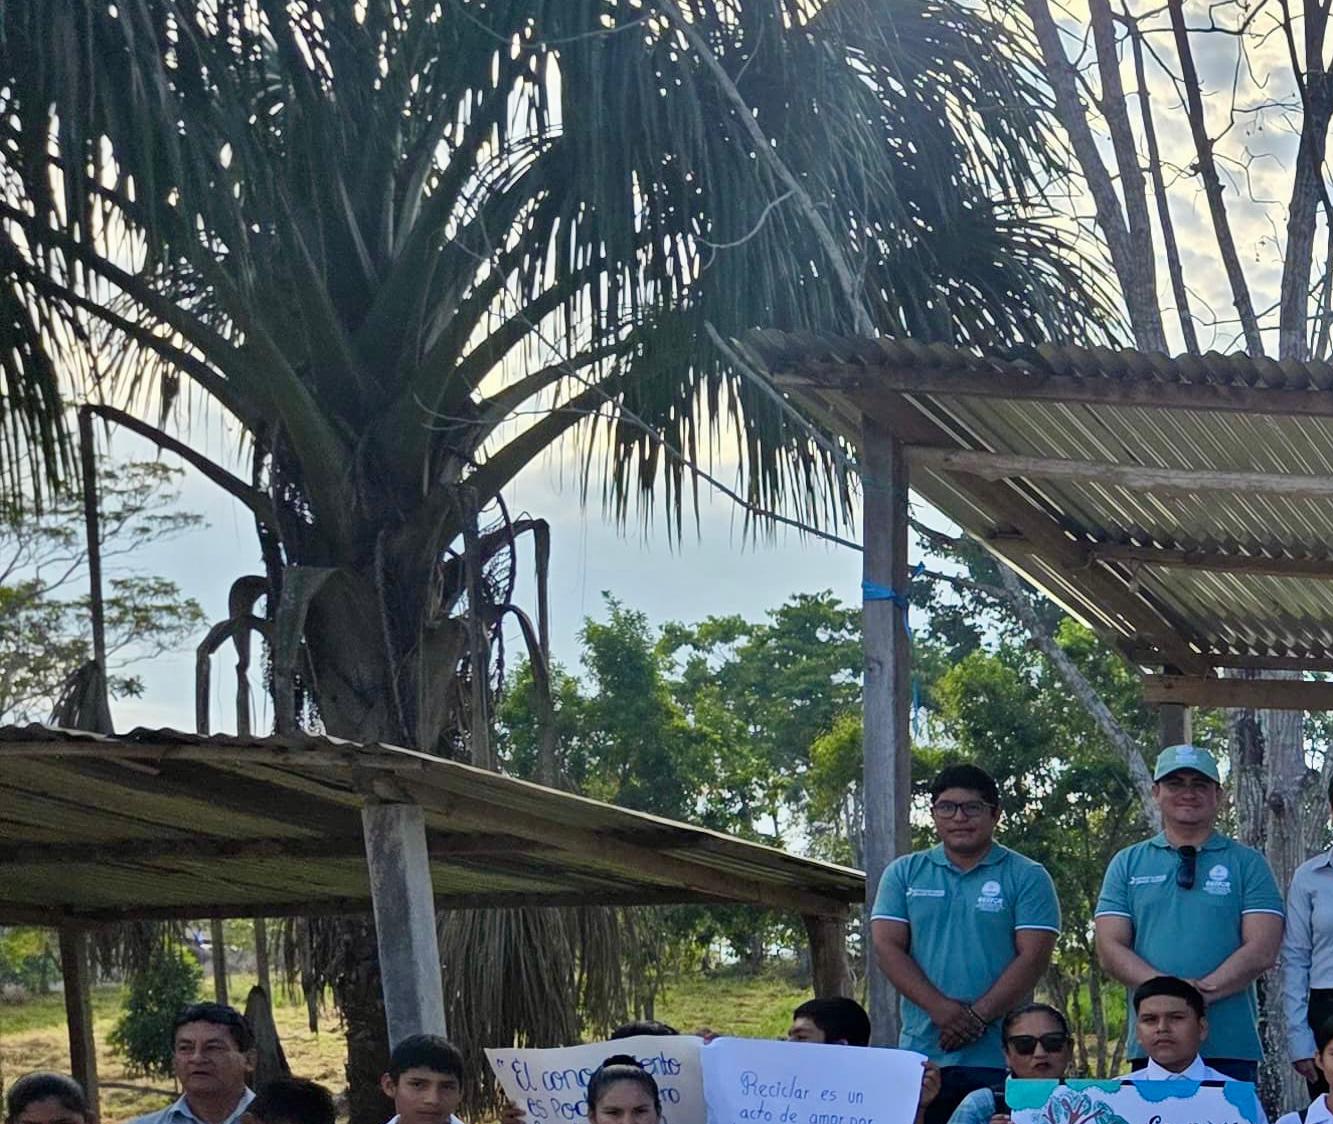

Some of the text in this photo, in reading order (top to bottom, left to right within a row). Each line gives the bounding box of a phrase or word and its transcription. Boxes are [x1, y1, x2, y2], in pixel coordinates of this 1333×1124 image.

[740, 1070, 864, 1104] Reciclar es un
[740, 1101, 772, 1121] acto
[780, 1104, 797, 1123] de
